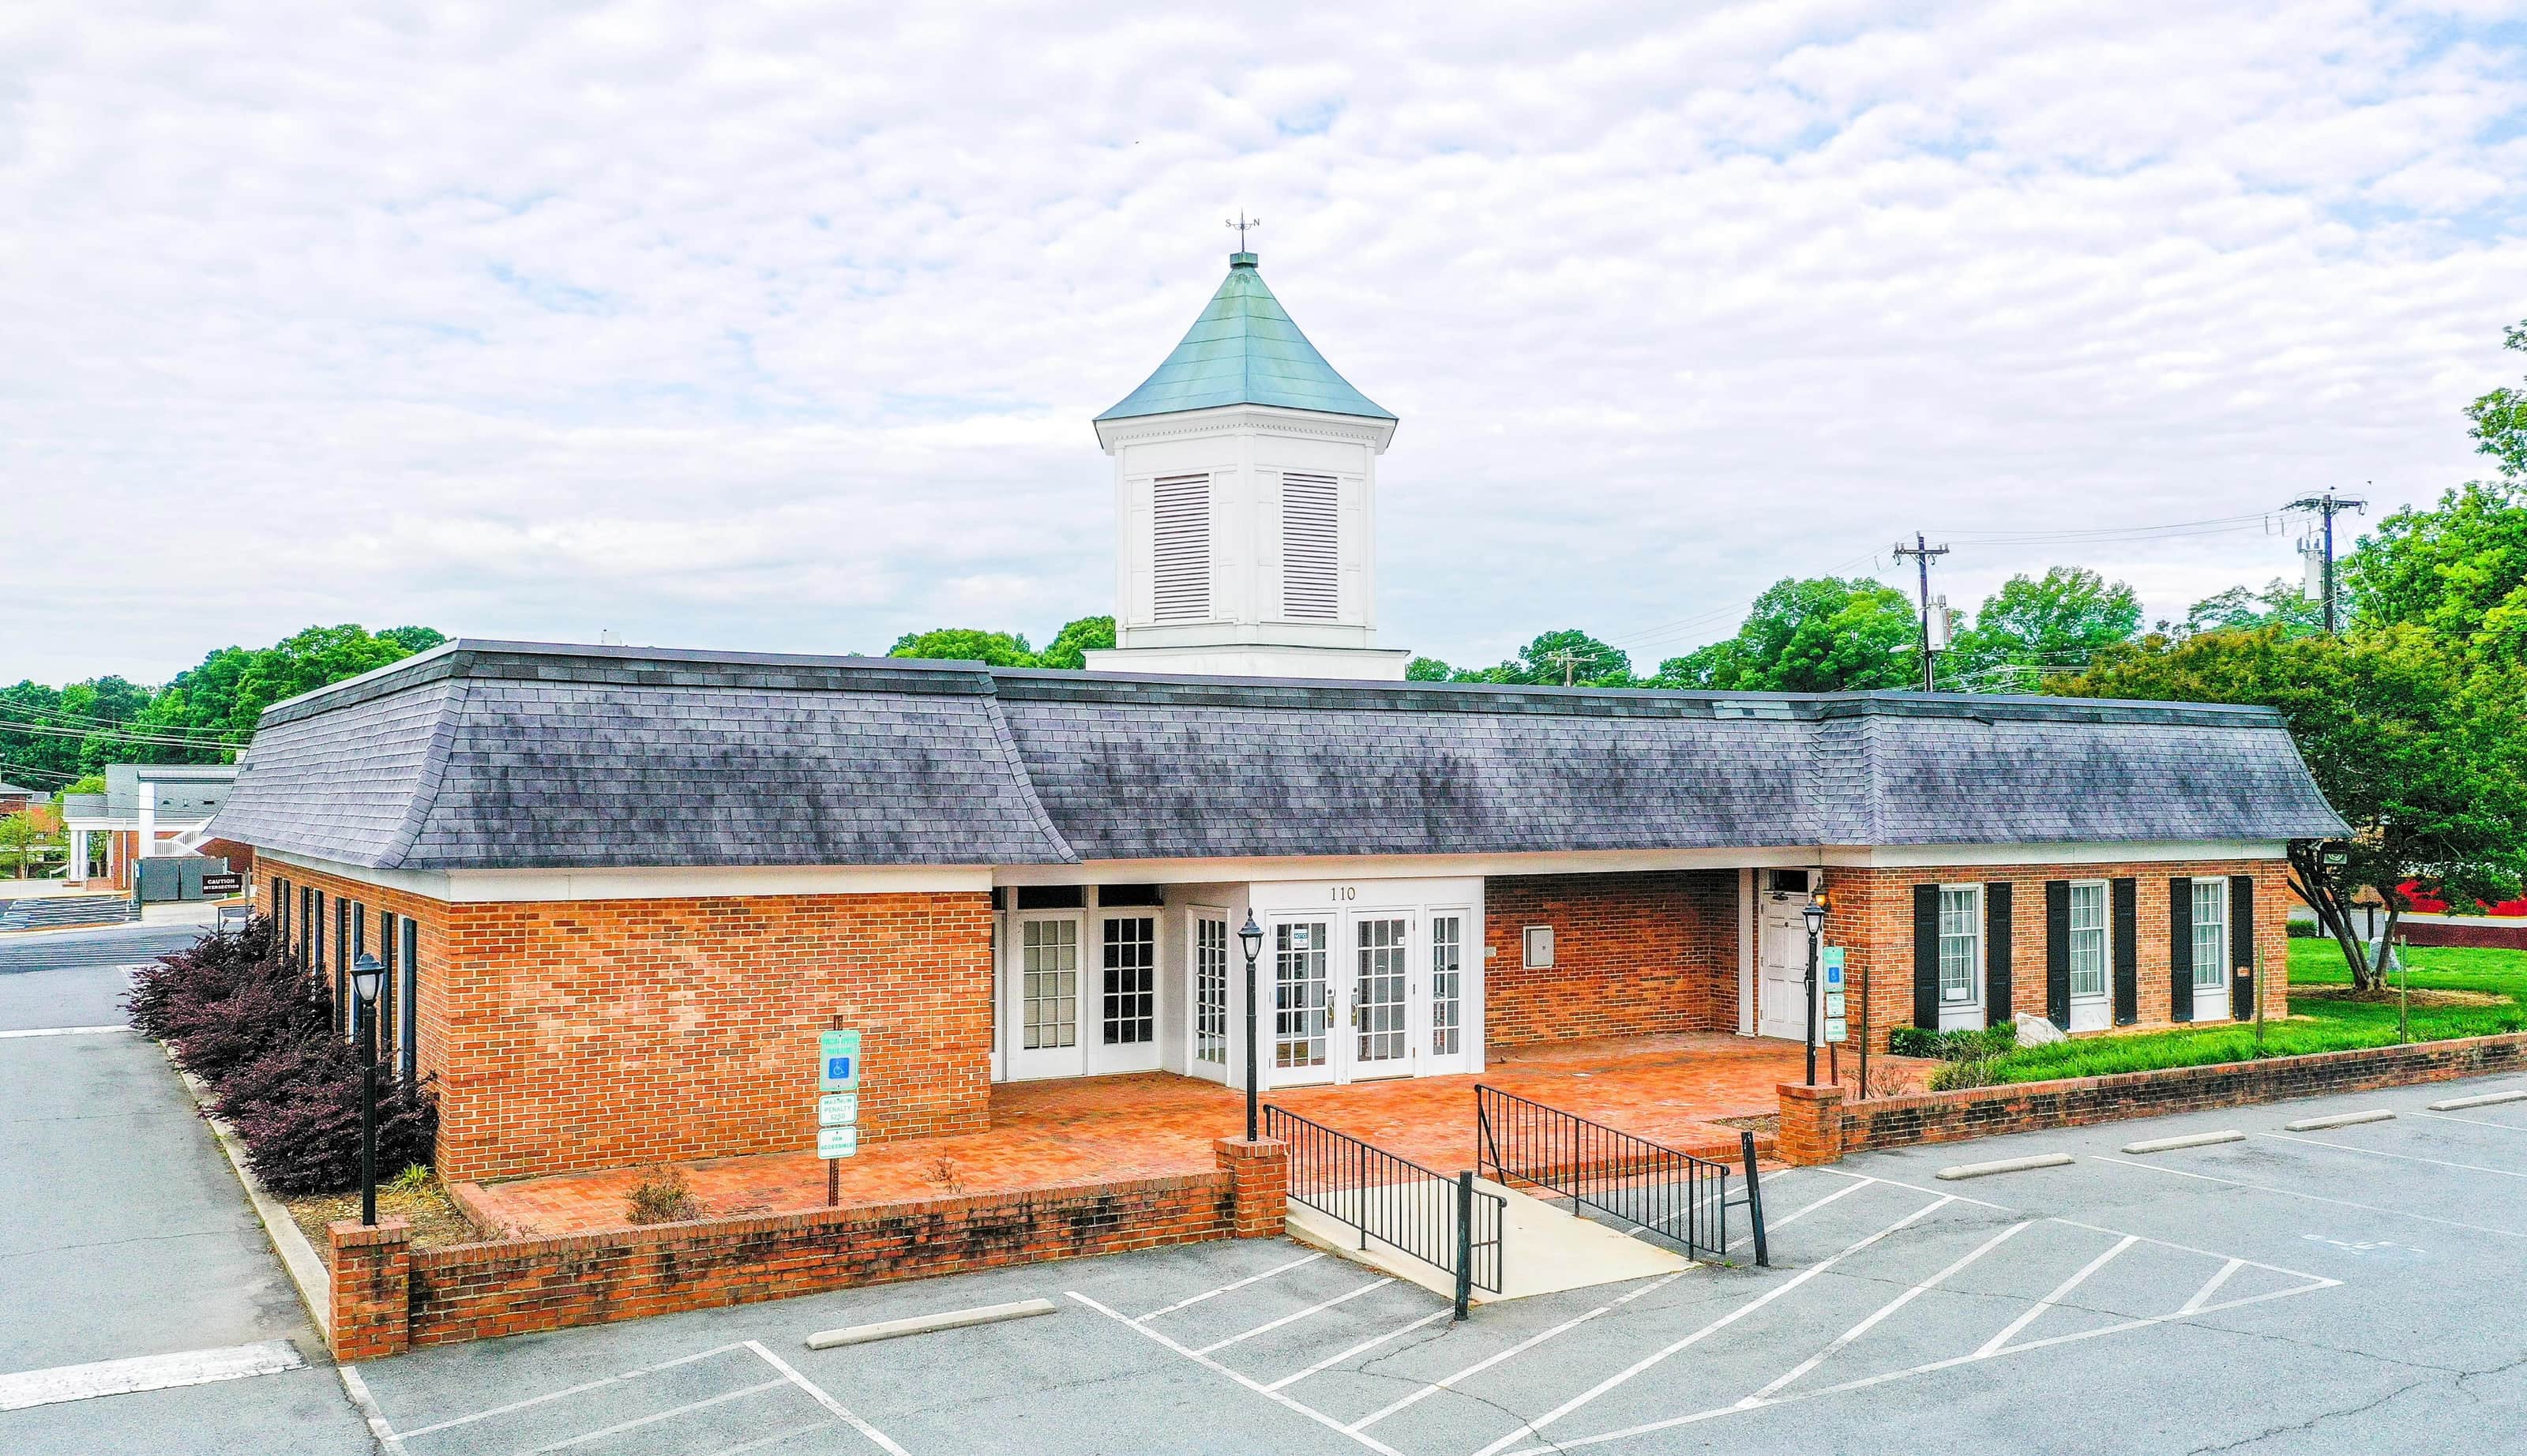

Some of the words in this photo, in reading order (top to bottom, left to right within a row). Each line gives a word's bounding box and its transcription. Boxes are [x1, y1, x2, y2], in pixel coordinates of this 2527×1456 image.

[1226, 219, 1232, 227] S
[1253, 218, 1260, 227] N
[1331, 887, 1355, 901] 110
